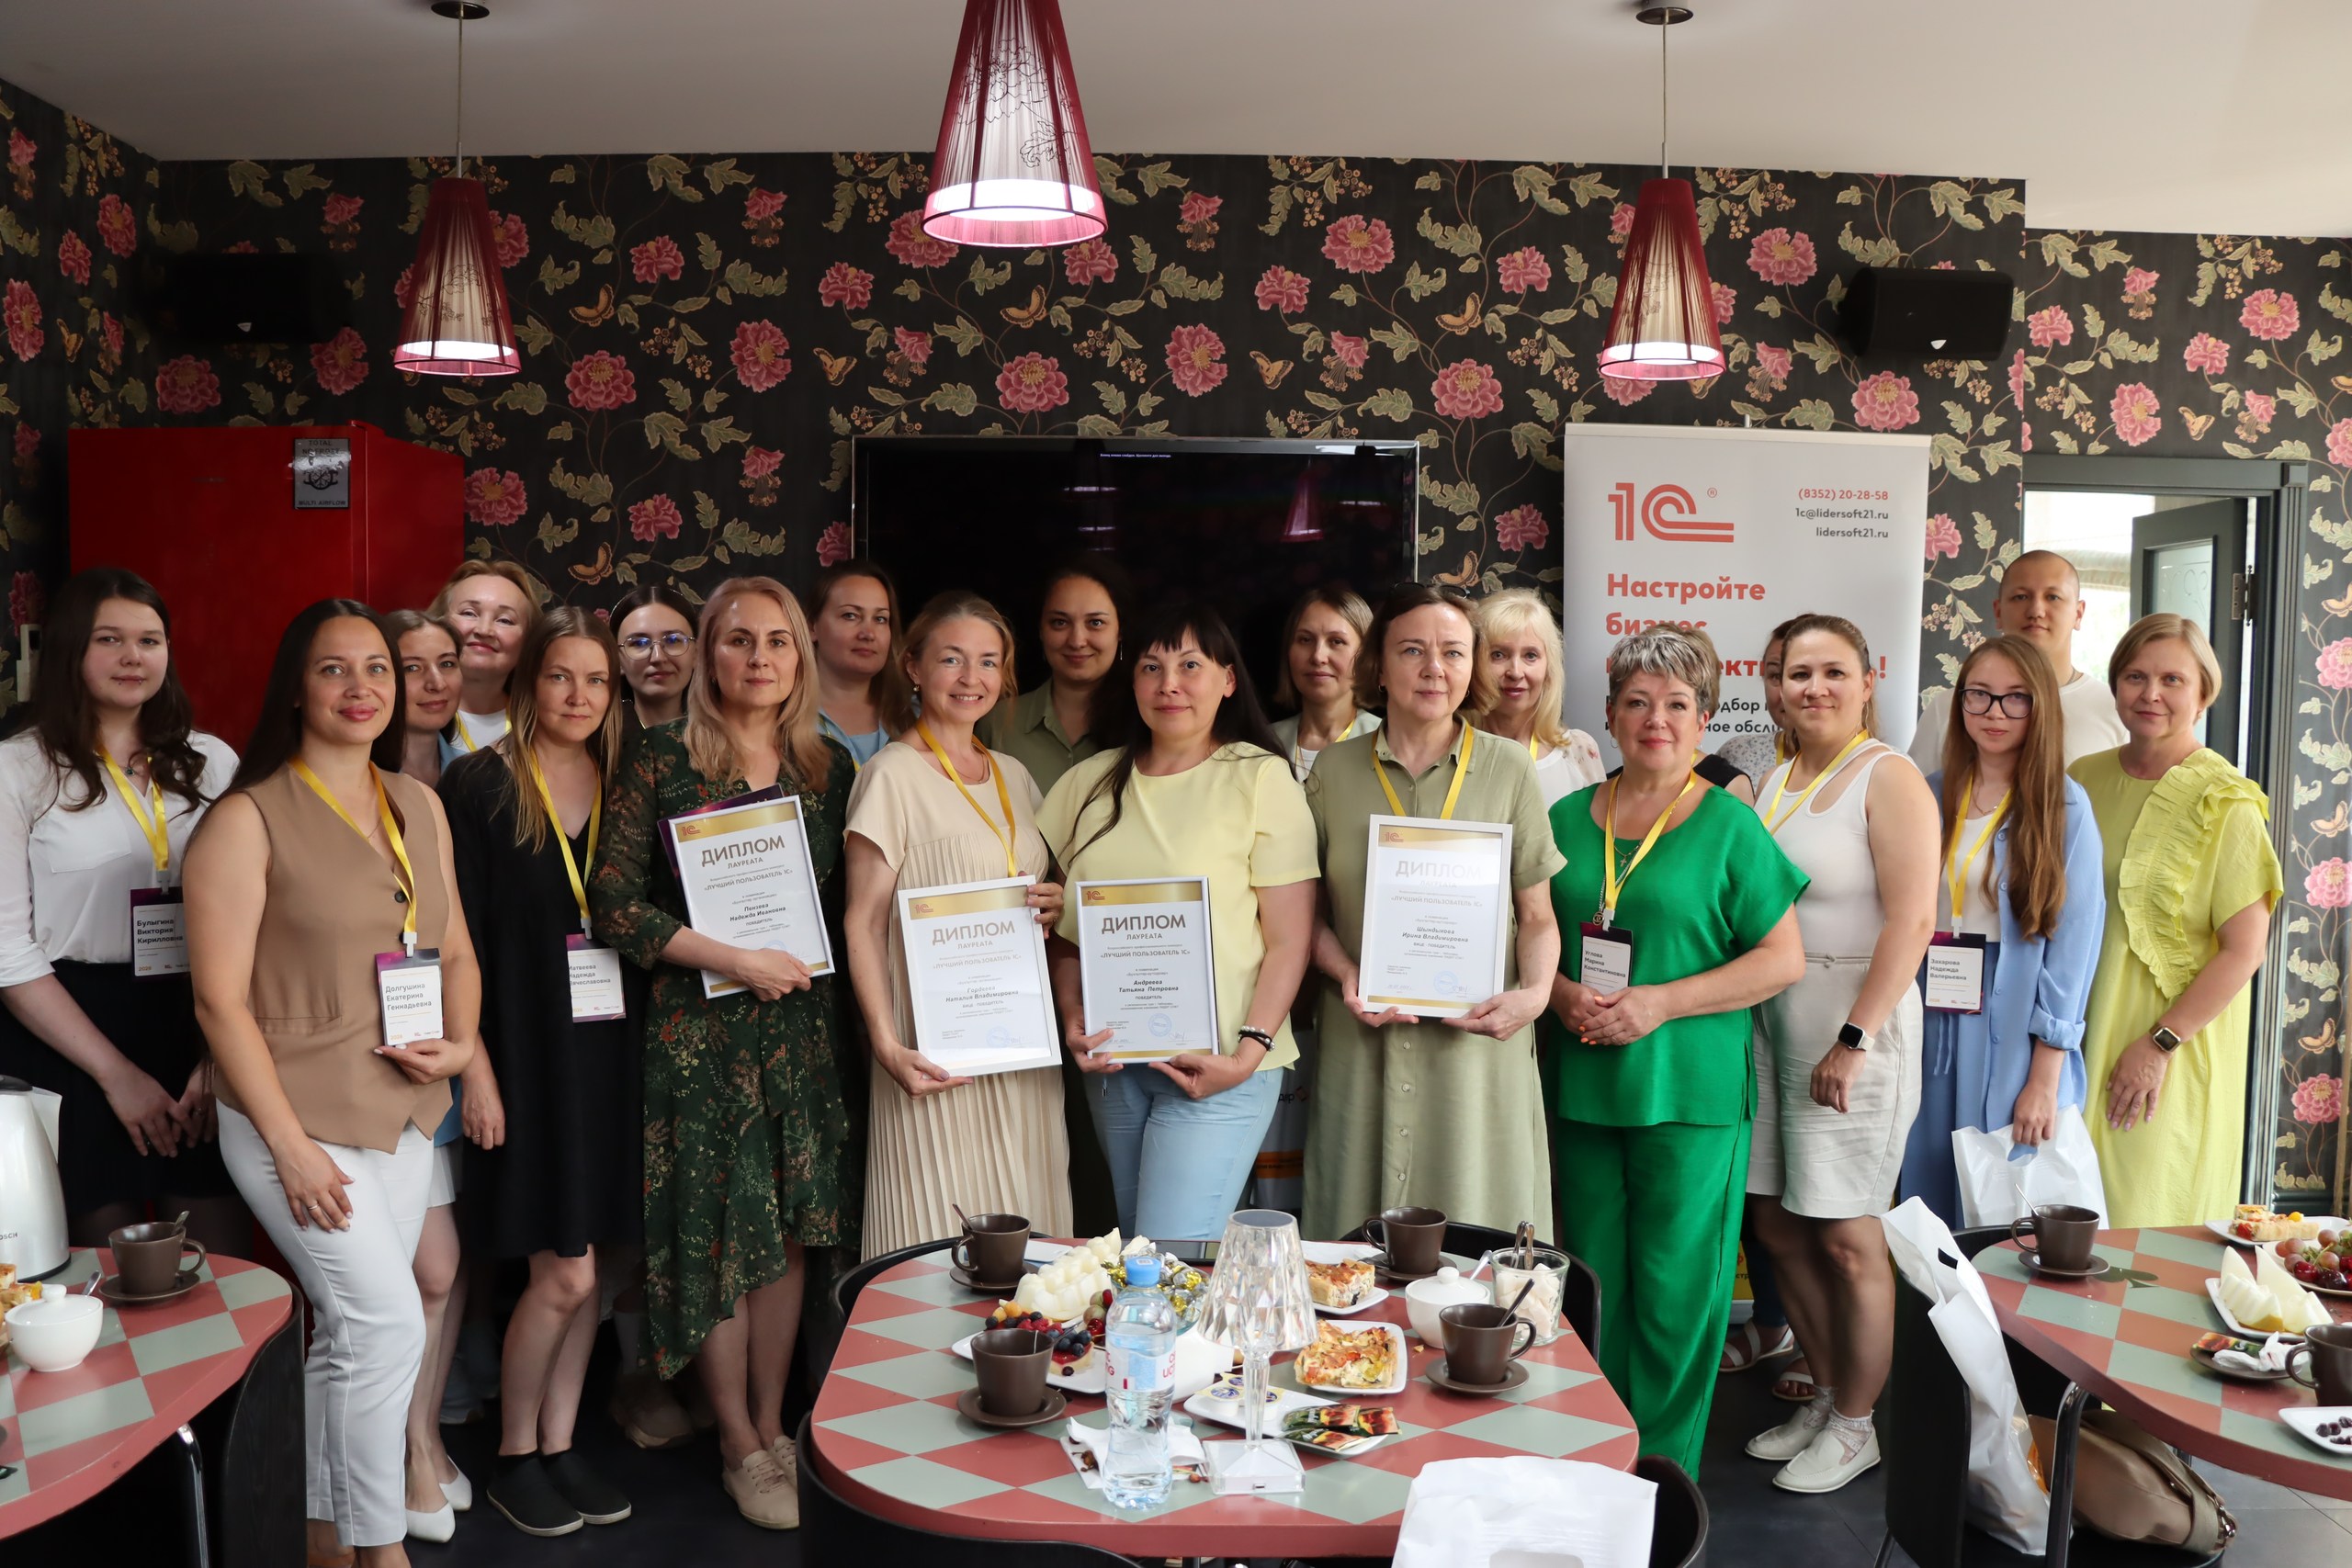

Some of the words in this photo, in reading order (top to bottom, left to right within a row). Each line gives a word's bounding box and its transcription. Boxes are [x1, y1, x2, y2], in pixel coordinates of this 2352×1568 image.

[1798, 488, 1836, 501] (8352)
[1838, 489, 1889, 501] 20-28-58
[1795, 507, 1889, 520] 1c@lidersoft21.ru
[1815, 526, 1889, 538] lidersoft21.ru
[1608, 573, 1766, 604] Настройте
[1606, 612, 1707, 636] бизес
[1720, 698, 1760, 714] дбор
[701, 835, 785, 867] ДИПЛОМ
[728, 857, 763, 869] ЛАУРЕАТА
[1396, 860, 1481, 880] ДИПЛОМ
[704, 879, 735, 891] «ЛУЧШИЙ
[735, 871, 782, 885] ПОЛЬЗОВАТЕЛЬ
[1423, 897, 1472, 907] ПОЛЬЗОВАТЕЛЬ
[729, 912, 755, 921] Надежда
[757, 906, 786, 916] Ивановна
[137, 919, 174, 928] Булыгина
[1102, 914, 1186, 934] ДИПЛОМ
[137, 927, 174, 935] Виктория
[933, 920, 1015, 945] ДИПЛОМ
[1402, 931, 1421, 940] Ирина
[1422, 933, 1469, 942] Владимировна
[137, 935, 184, 944] Кирилловна
[957, 941, 993, 949] ЛАУРЕАТА
[964, 956, 1011, 965] ПОЛЬЗОВАТЕЛЬ
[1101, 951, 1132, 959] «ЛУЧШИЙ
[1584, 957, 1604, 965] Марина
[1584, 964, 1625, 977] Константиновна
[386, 983, 425, 993] Долгушина
[387, 992, 424, 1002] Екатерина
[945, 994, 973, 1002] Наталия
[974, 990, 1019, 999] Владимировна
[387, 1000, 432, 1010] Геннадьевна
[1278, 1093, 1295, 1103] дер
[0, 1232, 17, 1240] OSCH
